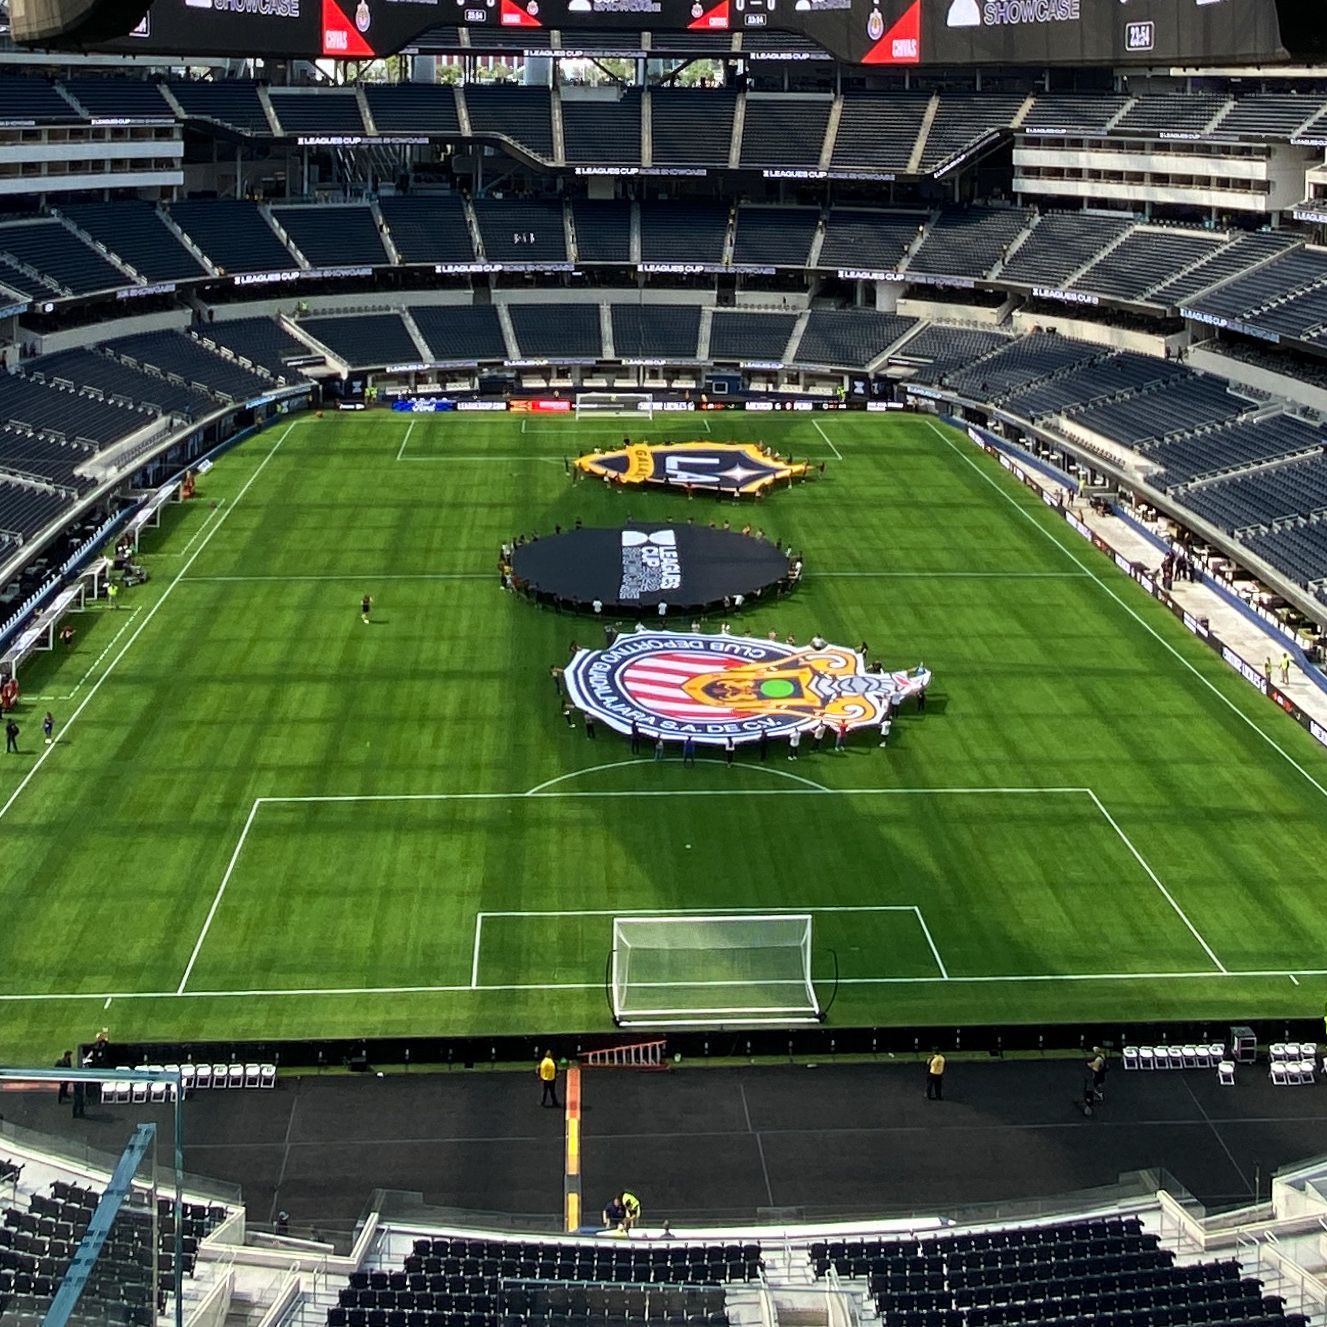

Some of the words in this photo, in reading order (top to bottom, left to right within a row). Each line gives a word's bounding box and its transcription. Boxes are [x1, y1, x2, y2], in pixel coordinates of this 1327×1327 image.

[665, 456, 720, 483] LA
[641, 546, 660, 567] CUP
[658, 545, 681, 590] LEAGUES
[600, 639, 704, 665] DEPORTIVO
[710, 641, 766, 660] CLUB
[588, 659, 656, 725] GUADALAJARA
[707, 725, 740, 733] DE
